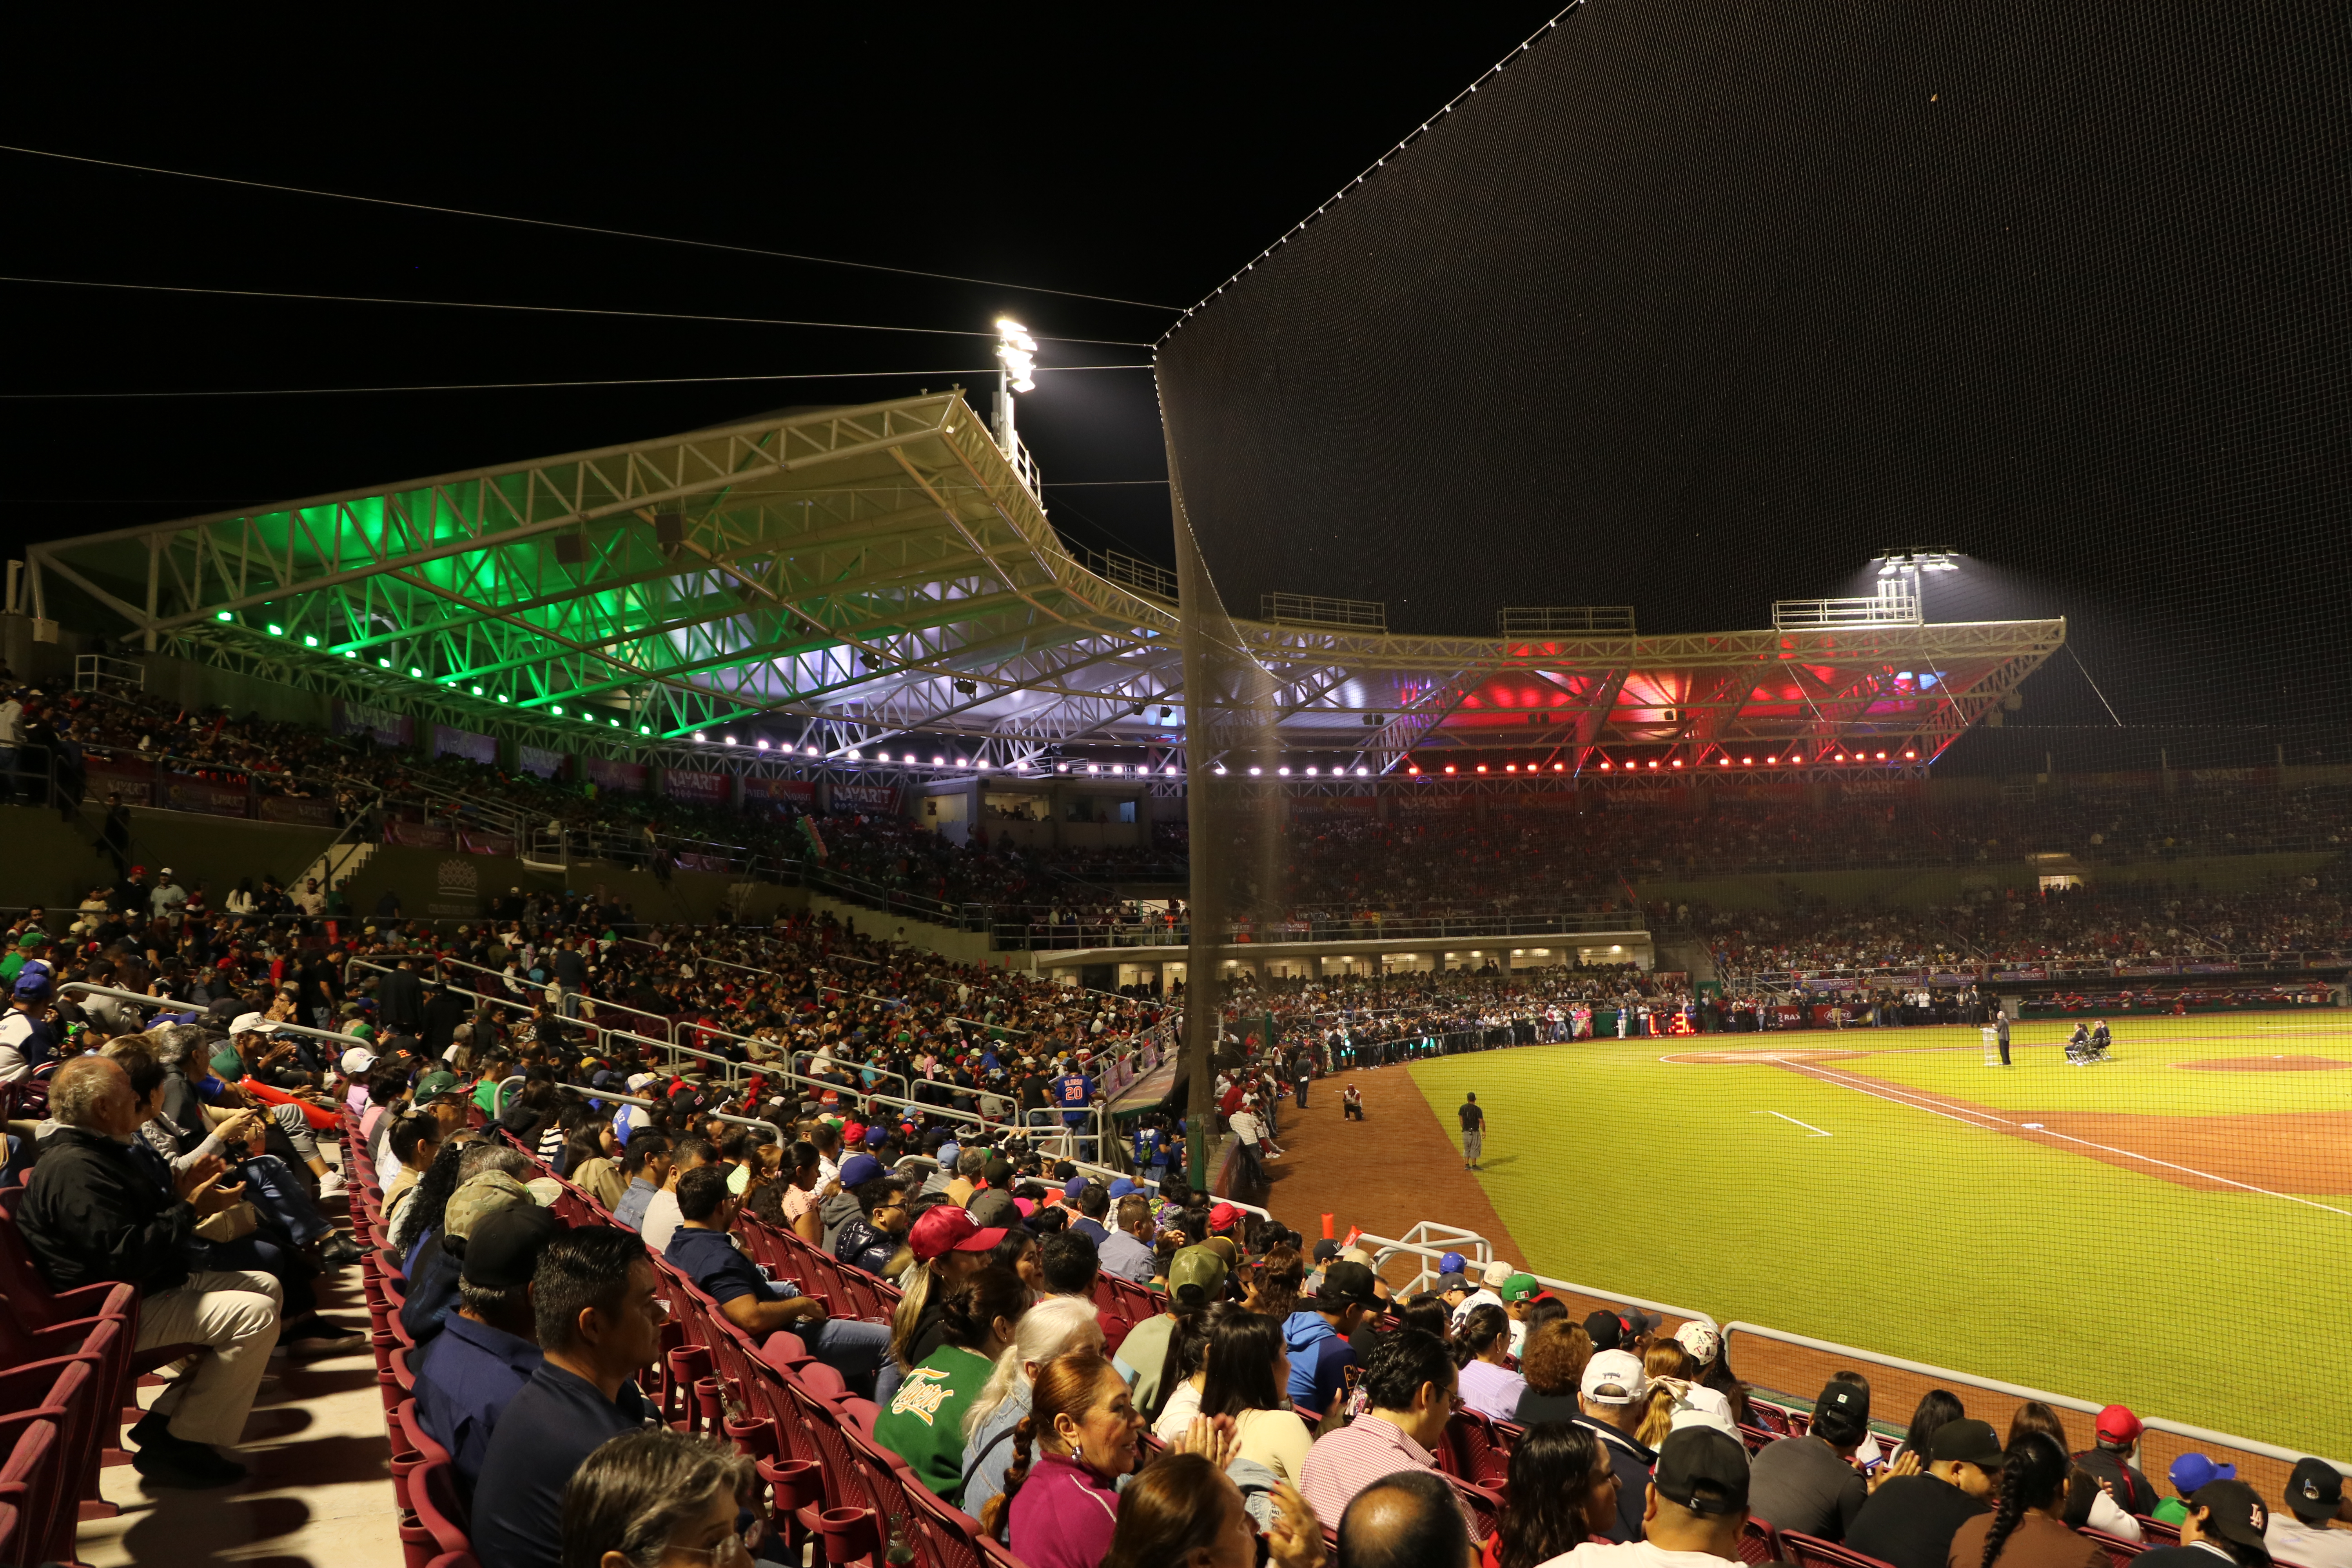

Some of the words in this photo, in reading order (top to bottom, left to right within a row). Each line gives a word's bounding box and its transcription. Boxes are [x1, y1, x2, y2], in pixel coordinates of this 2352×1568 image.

[345, 701, 401, 735] NAYARIT
[668, 770, 720, 791] NAYARIT
[2192, 768, 2255, 781] NAYARIT
[784, 789, 811, 801] NAYARIT
[834, 786, 891, 804] NAYARIT
[1842, 781, 1906, 795] NAYARIT
[211, 793, 246, 807] NAYARIT
[1399, 796, 1462, 809] NAYARIT
[1605, 789, 1671, 802] NAYARIT
[1293, 804, 1324, 813] RIVIERA
[1340, 804, 1372, 813] NAYARIT
[396, 1049, 411, 1058] H
[1065, 1086, 1083, 1100] 20
[891, 1366, 954, 1426] Tigers
[2249, 1503, 2264, 1530] LA
